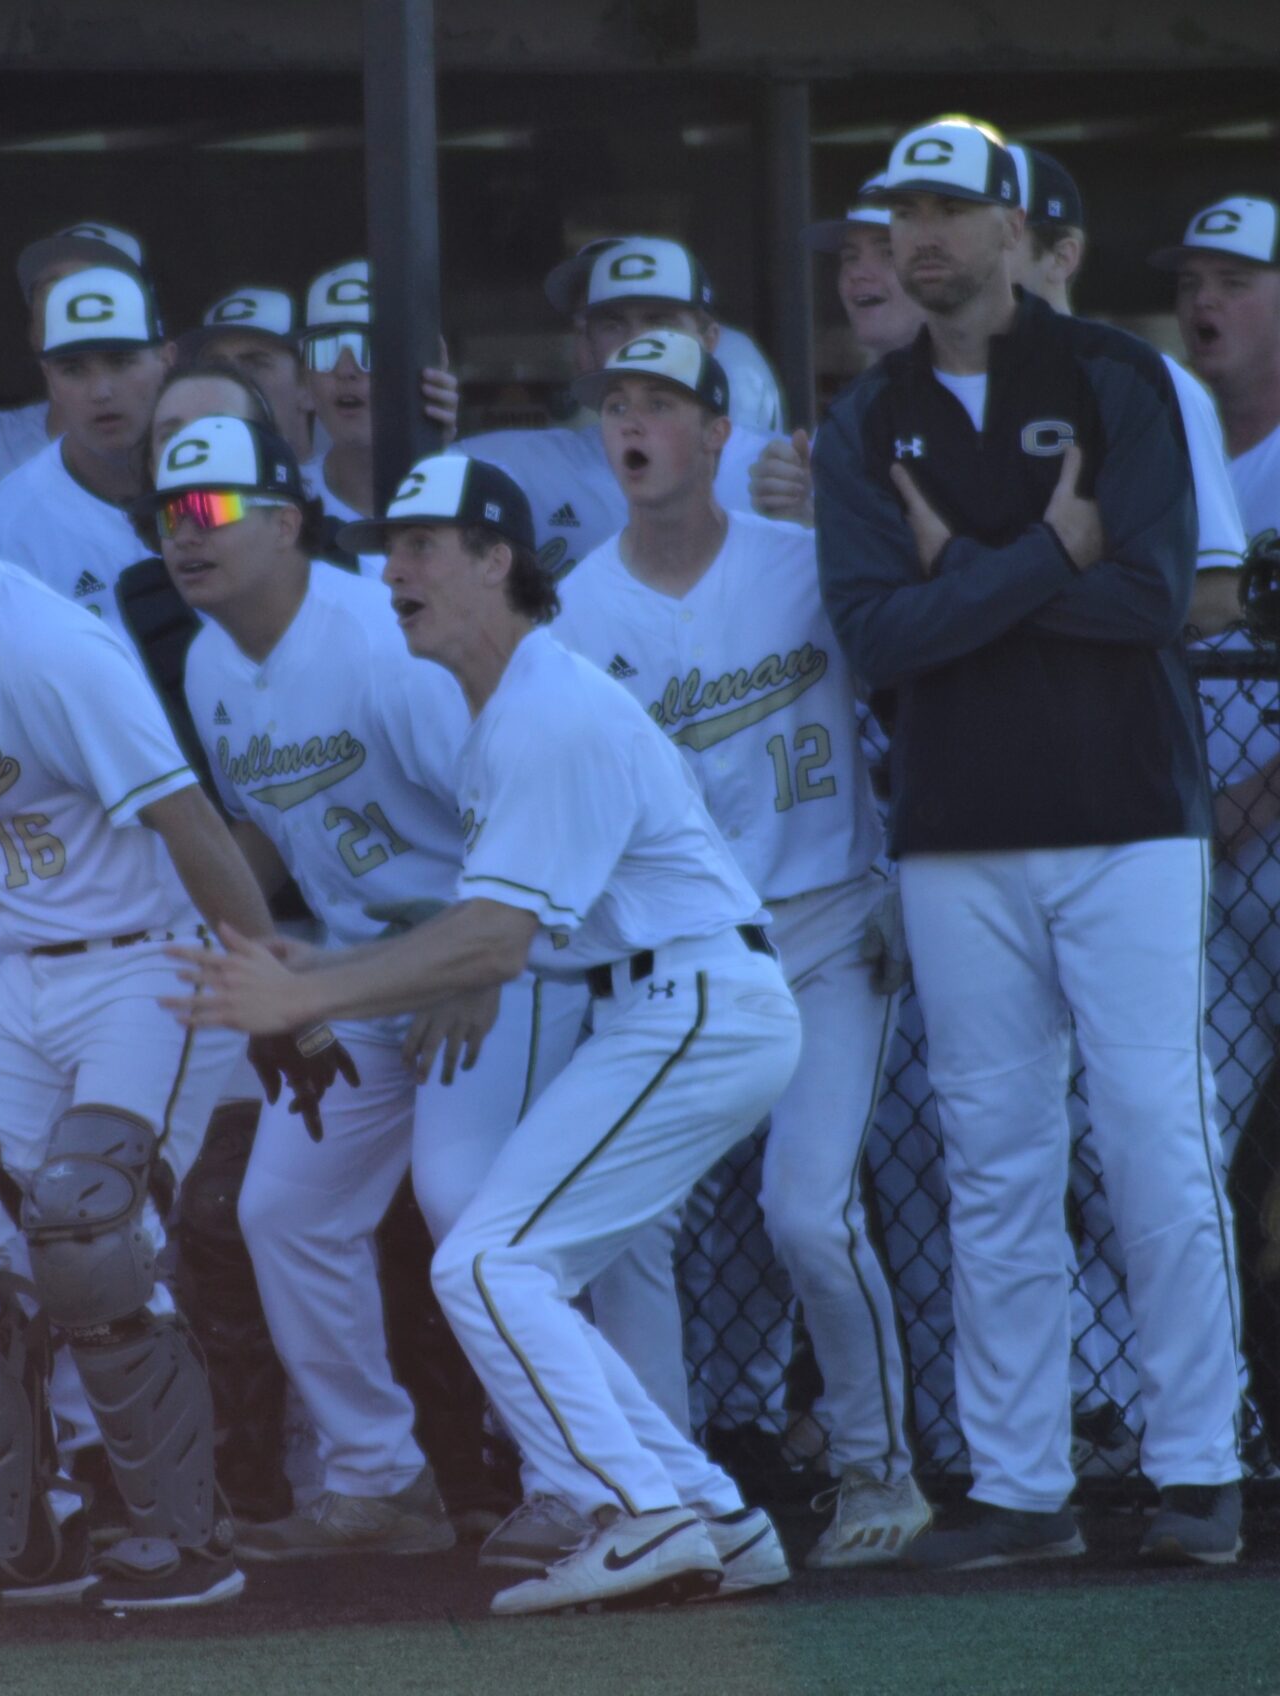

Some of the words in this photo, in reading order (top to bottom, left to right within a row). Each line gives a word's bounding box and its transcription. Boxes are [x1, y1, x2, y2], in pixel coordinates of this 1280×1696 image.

[902, 138, 954, 166] C
[1195, 209, 1241, 235] C
[609, 253, 657, 281] C
[326, 279, 370, 306] C
[66, 292, 115, 324] C
[214, 298, 258, 323] C
[615, 338, 667, 363] C
[1021, 420, 1074, 457] C
[166, 438, 211, 473] C
[766, 722, 837, 813] 12
[323, 800, 415, 878] 21
